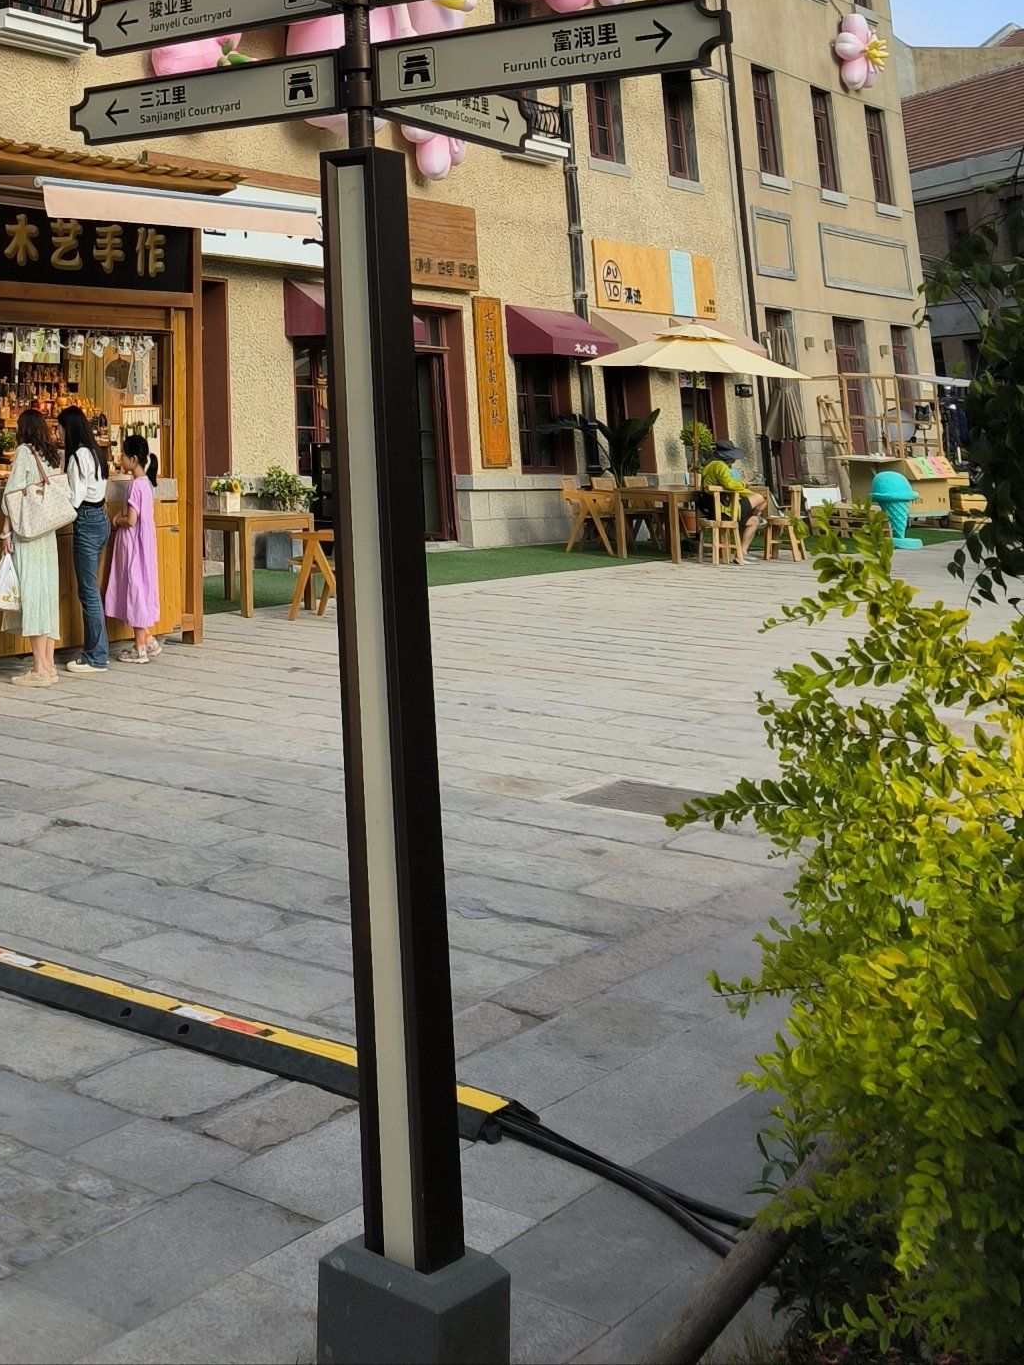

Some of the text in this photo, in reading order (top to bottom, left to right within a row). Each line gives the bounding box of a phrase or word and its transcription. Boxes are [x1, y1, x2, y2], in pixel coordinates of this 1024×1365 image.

[149, 8, 232, 33] Junyeli Courtryard
[552, 22, 619, 52] 富润里
[503, 47, 622, 74] Furunli Courtryard
[139, 85, 187, 109] 三江里
[139, 100, 241, 125] Sanjiangli Courtryard
[3, 213, 167, 279] 木艺手作
[574, 342, 599, 356] 木心堂
